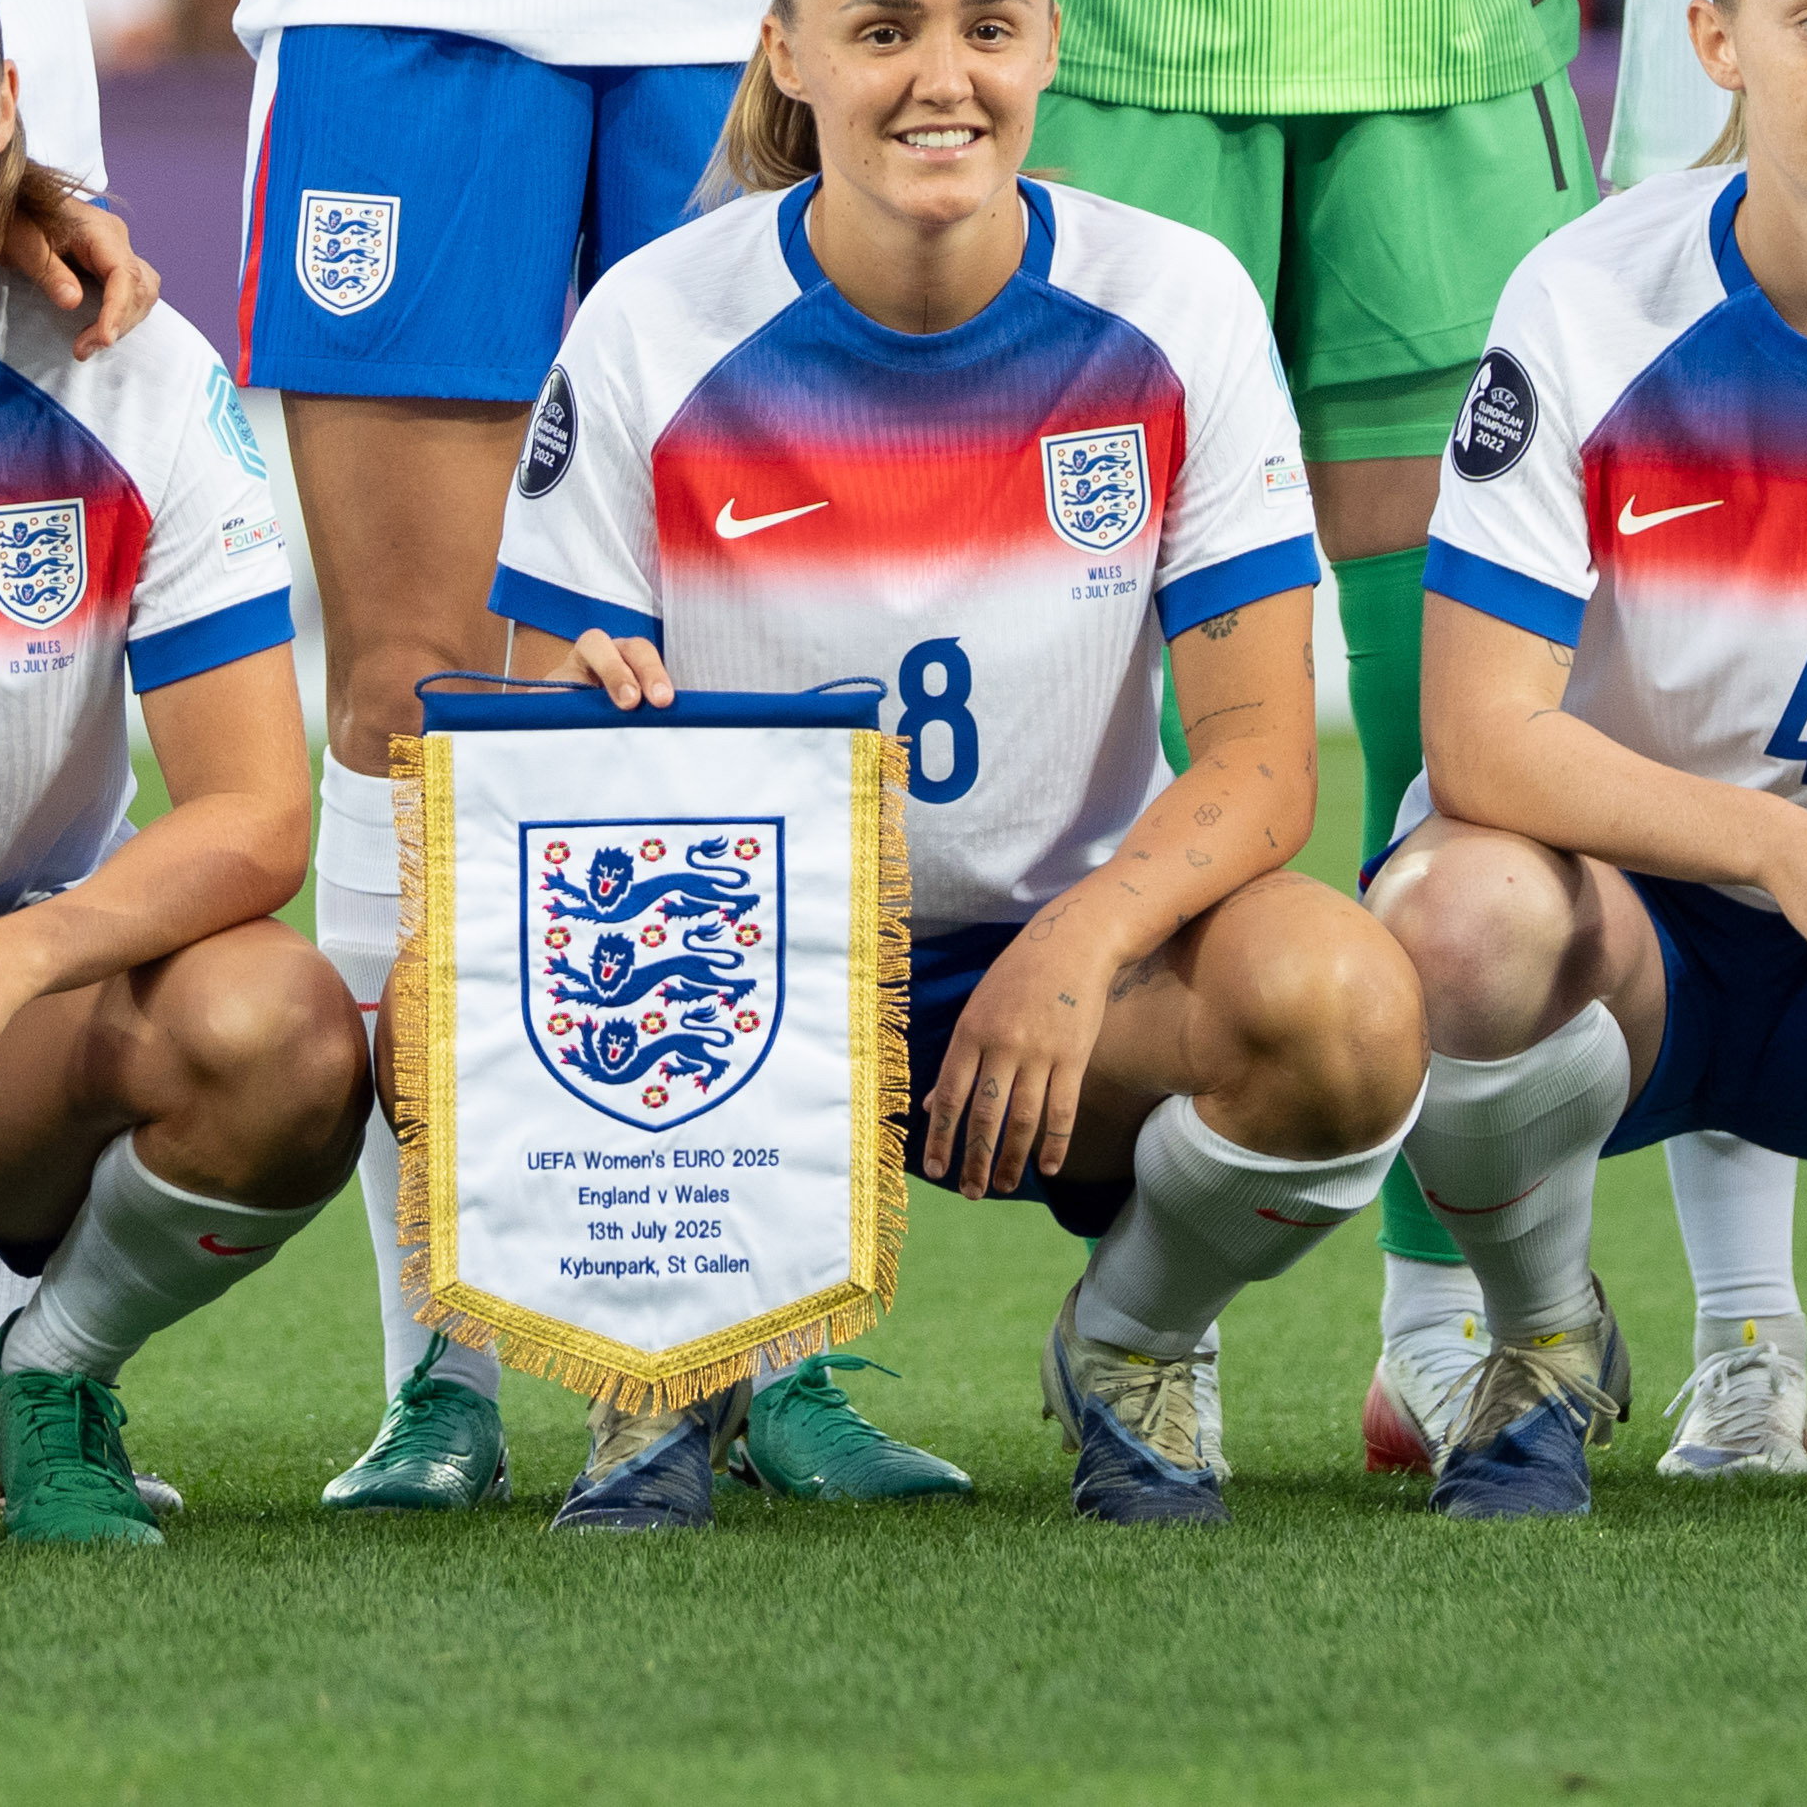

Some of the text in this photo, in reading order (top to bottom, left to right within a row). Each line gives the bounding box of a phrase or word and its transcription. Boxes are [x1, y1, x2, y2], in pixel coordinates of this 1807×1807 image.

[1490, 387, 1519, 411] UEFA
[1478, 400, 1524, 430] EUROPEAN
[1473, 412, 1522, 442] CHAMPIONS
[1475, 429, 1506, 453] 2022
[534, 447, 556, 468] 2022
[1265, 455, 1285, 467] UEFA
[222, 516, 245, 531] UEFA
[1087, 565, 1122, 581] WALES
[1071, 579, 1138, 600] 13 JULY 2025
[27, 640, 61, 654] WALES
[10, 652, 75, 674] 13 JULY 2025
[896, 636, 979, 804] 8
[528, 1148, 780, 1170] UEFA Women's EURO 2025
[578, 1185, 730, 1209] England v Wales
[587, 1220, 722, 1243] 13th July 2025
[560, 1254, 750, 1280] Kybunpark, St Gallen
